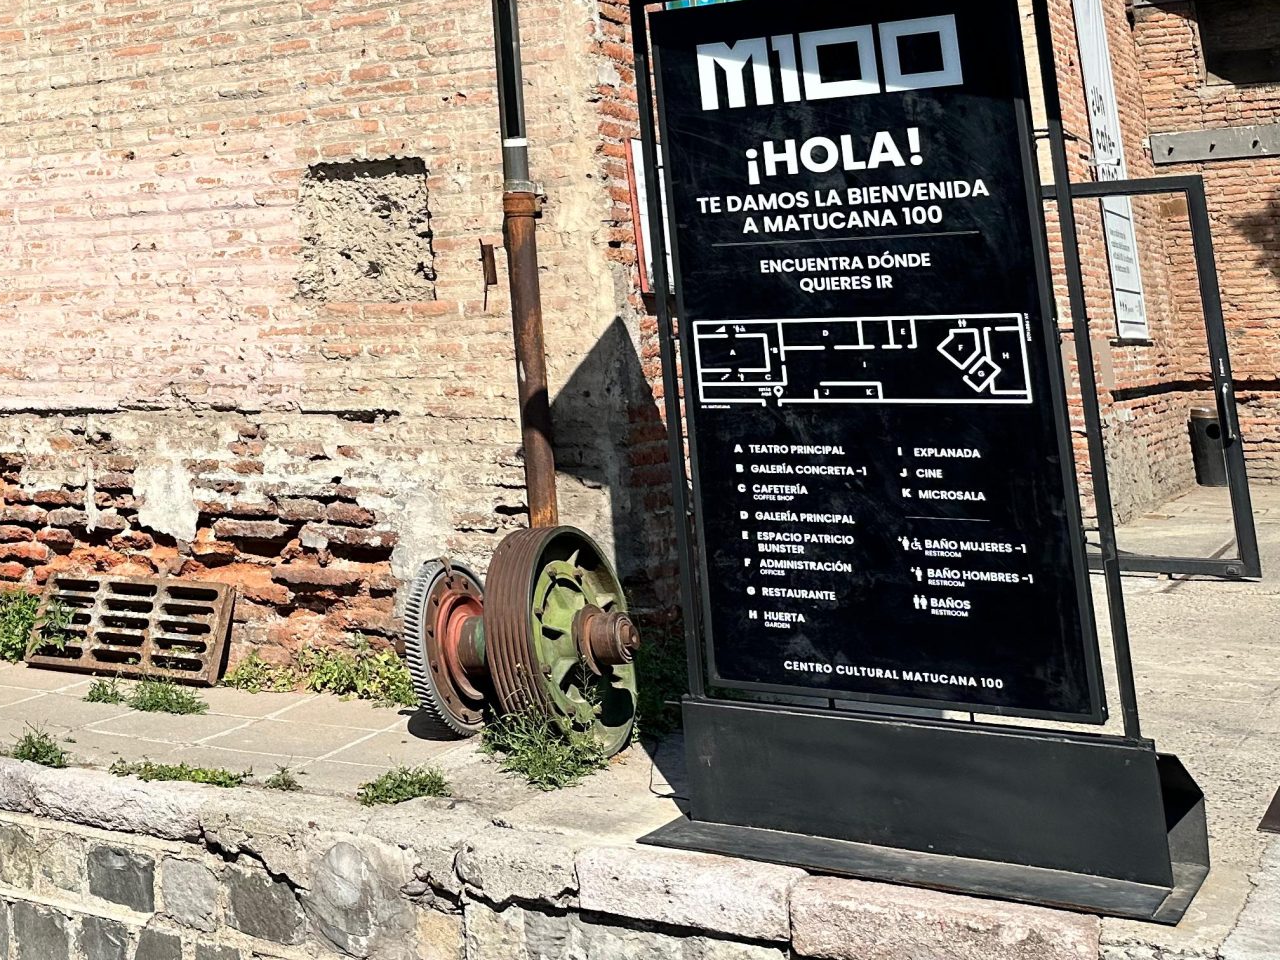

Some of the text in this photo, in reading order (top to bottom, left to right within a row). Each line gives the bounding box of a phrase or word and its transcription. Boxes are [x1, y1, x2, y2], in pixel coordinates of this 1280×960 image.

[696, 14, 963, 110] M100
[746, 128, 924, 186] ¡HOLA!
[697, 179, 989, 213] TE DAMOS LA BIENVENIDA
[743, 206, 942, 233] A MATUCANA 100
[760, 251, 931, 273] ENCUENTRA DÓNDE
[800, 275, 892, 293] QUIERES IR
[734, 444, 845, 454] A TEATRO PRINCIPAL
[914, 448, 980, 458] EXPLANADA
[736, 464, 743, 472] B
[751, 463, 794, 474] GALERÍA
[796, 466, 854, 475] CONCRETA
[900, 469, 942, 478] J CINE
[738, 484, 808, 494] C CAFETERÍA
[902, 488, 985, 501] K MICROSALA
[740, 511, 855, 524] D GALERÍA PRINCIPAL
[742, 531, 854, 544] E ESPACIO PATRICIO
[758, 543, 804, 554] BUNSTER
[924, 539, 958, 551] BAÑO
[959, 542, 1012, 553] MUJERES
[744, 558, 852, 573] F ADMINISTRACIÓN
[927, 568, 960, 580] BAÑO
[962, 571, 1019, 583] HOMBRES
[928, 579, 965, 587] RESTROOM
[747, 587, 836, 600] G RESTAURANTE
[931, 597, 971, 610] BAÑOS
[749, 610, 805, 624] H HUERTA
[784, 661, 1003, 688] CENTRO CULTURAL MATUCANA 100
